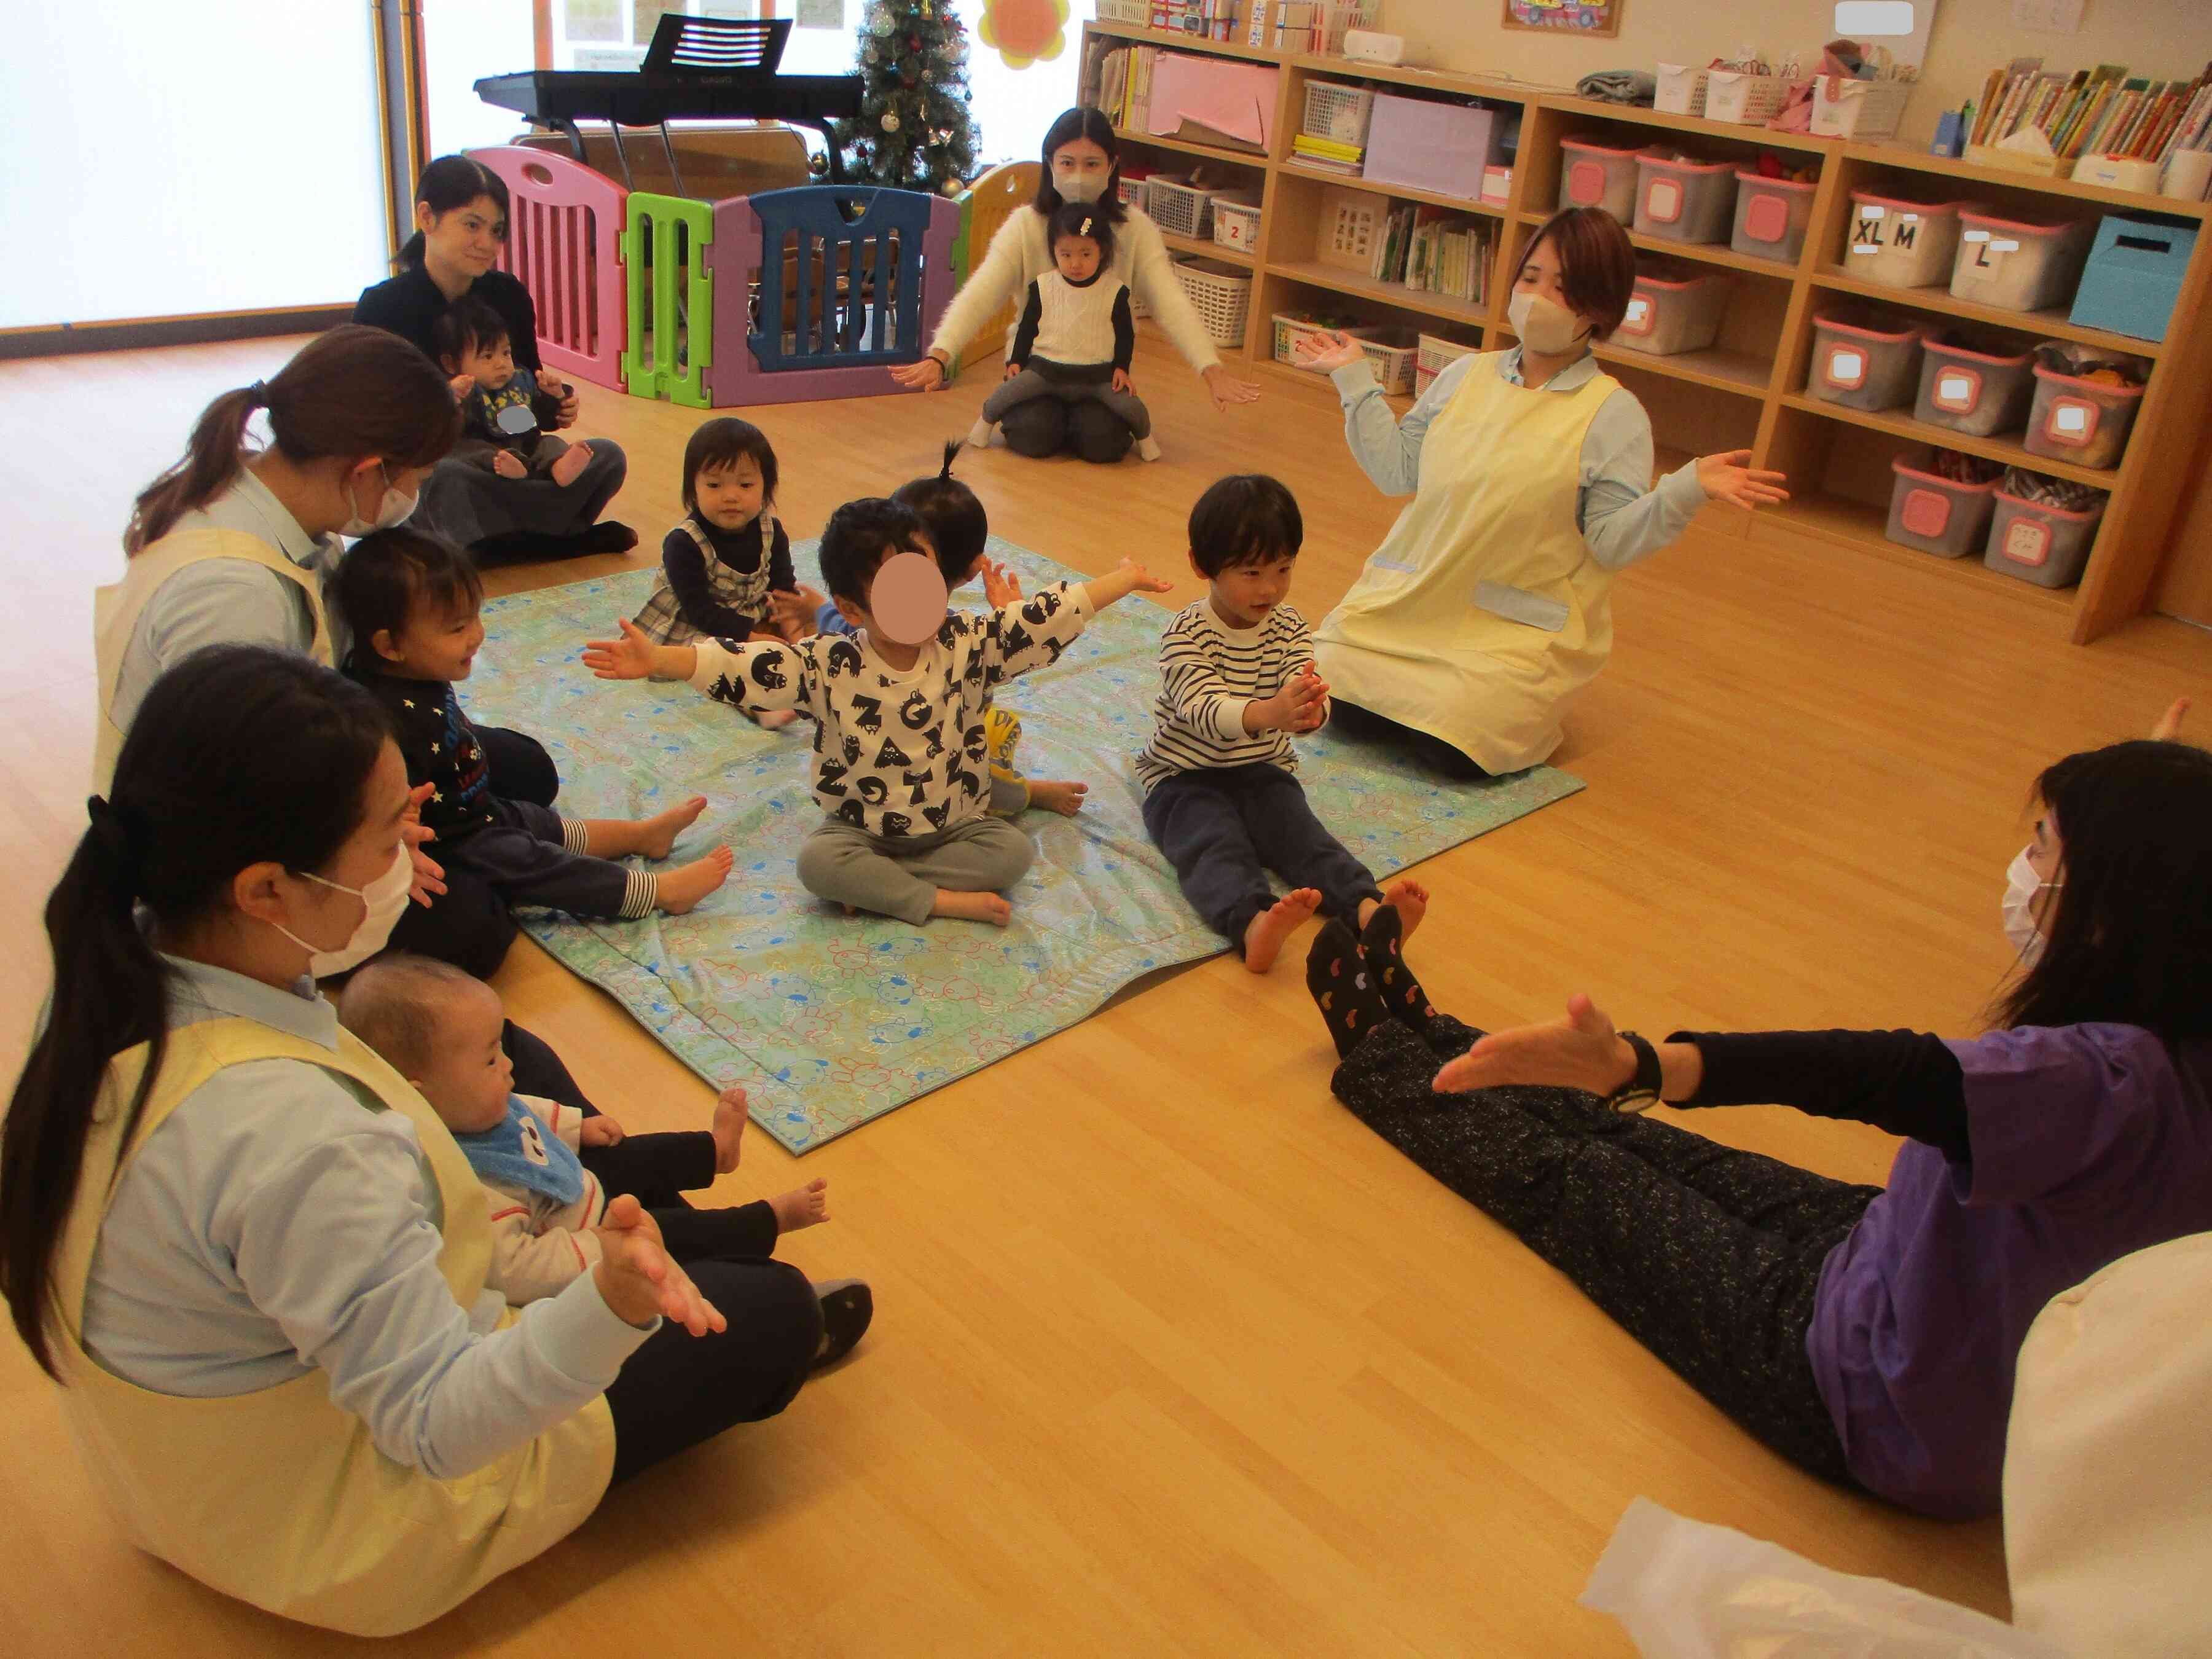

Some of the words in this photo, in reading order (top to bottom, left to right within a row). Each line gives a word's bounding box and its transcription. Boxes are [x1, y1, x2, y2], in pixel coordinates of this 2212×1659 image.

[1231, 226, 1239, 238] 2
[1854, 219, 1884, 246] XL
[1893, 223, 1916, 249] M
[1975, 244, 1990, 268] L
